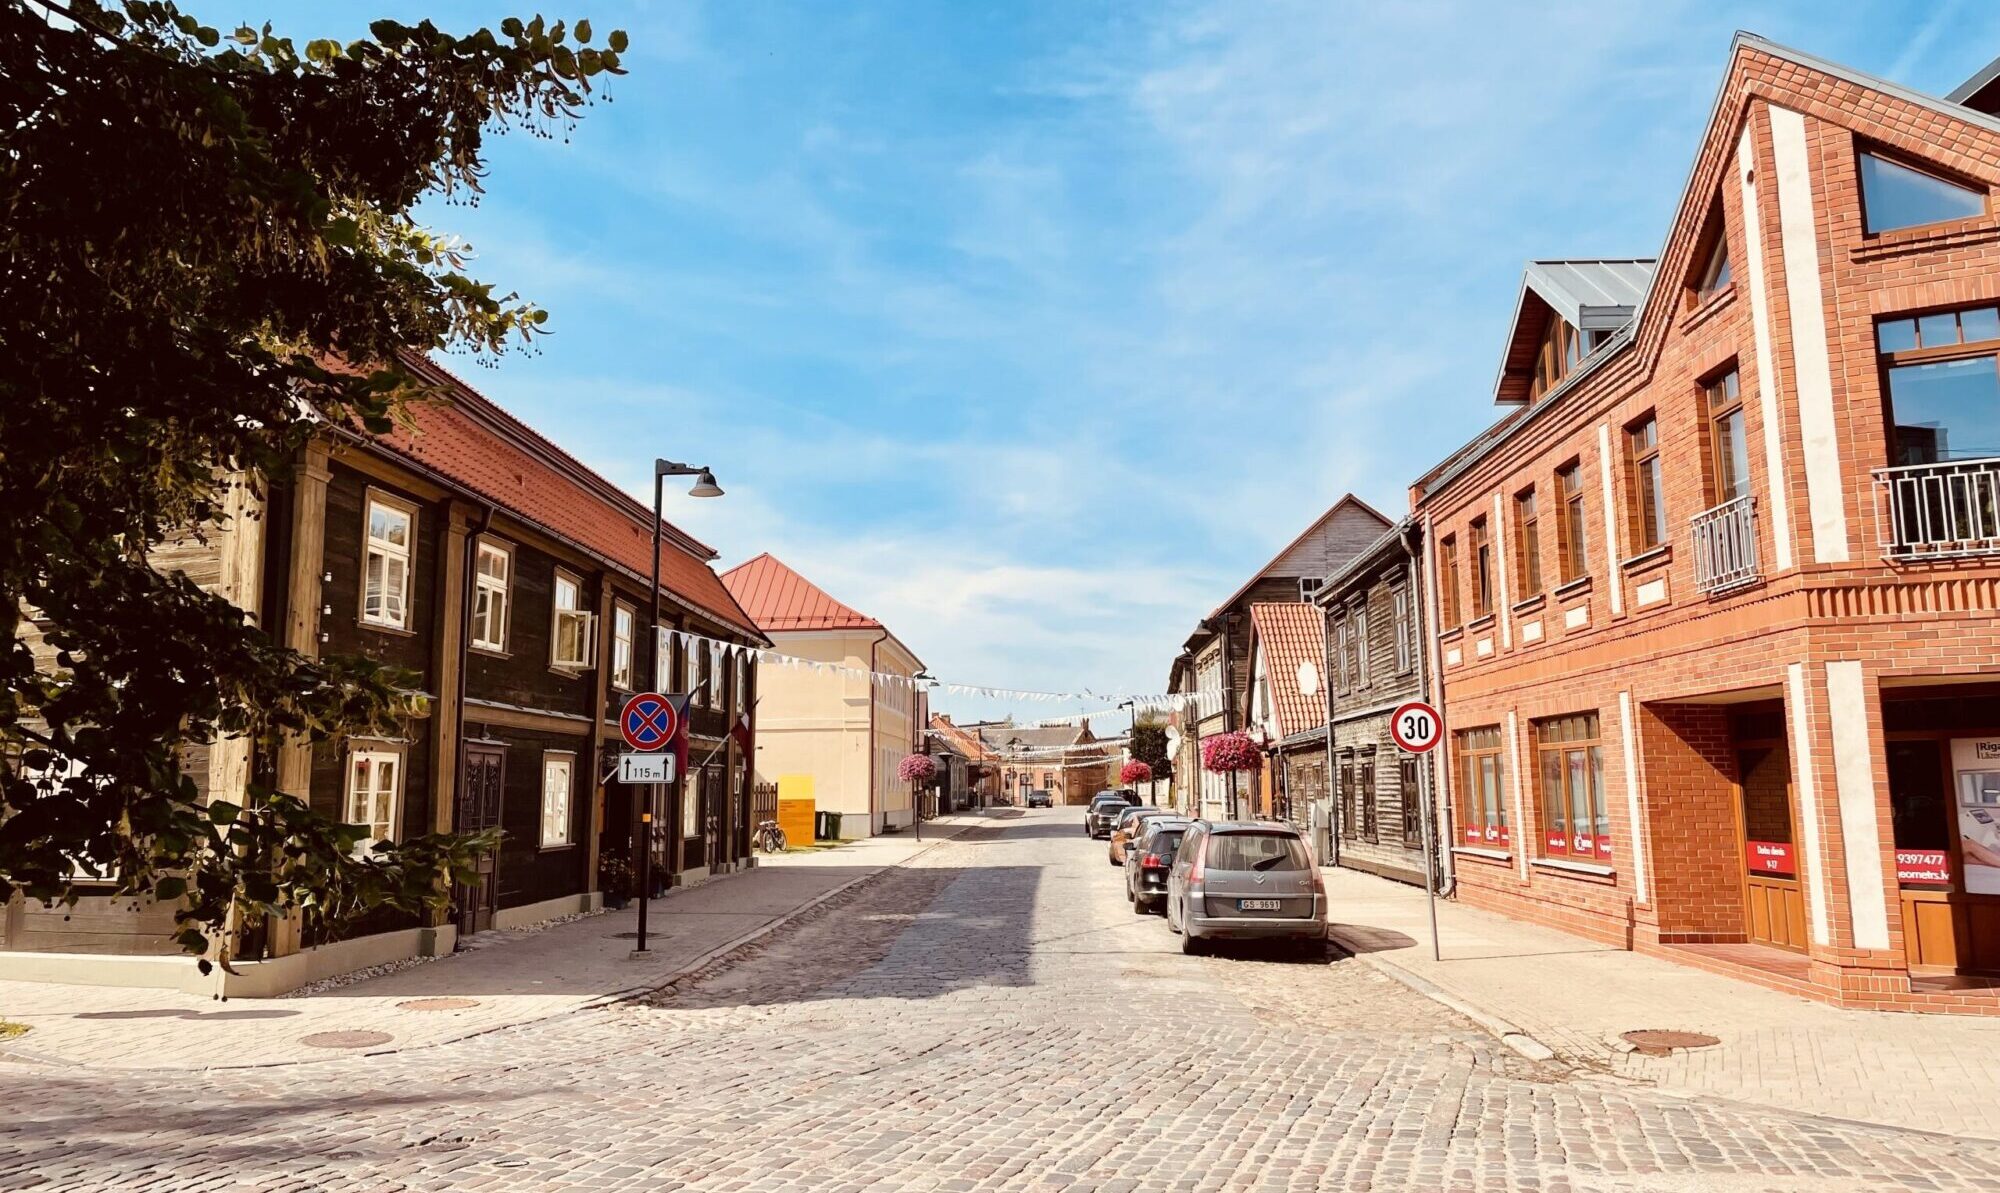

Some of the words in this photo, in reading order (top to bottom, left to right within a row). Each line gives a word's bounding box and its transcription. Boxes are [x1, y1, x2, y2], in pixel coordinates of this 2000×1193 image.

[1404, 716, 1429, 740] 30
[634, 768, 650, 778] 115
[1897, 853, 1944, 865] 9397477
